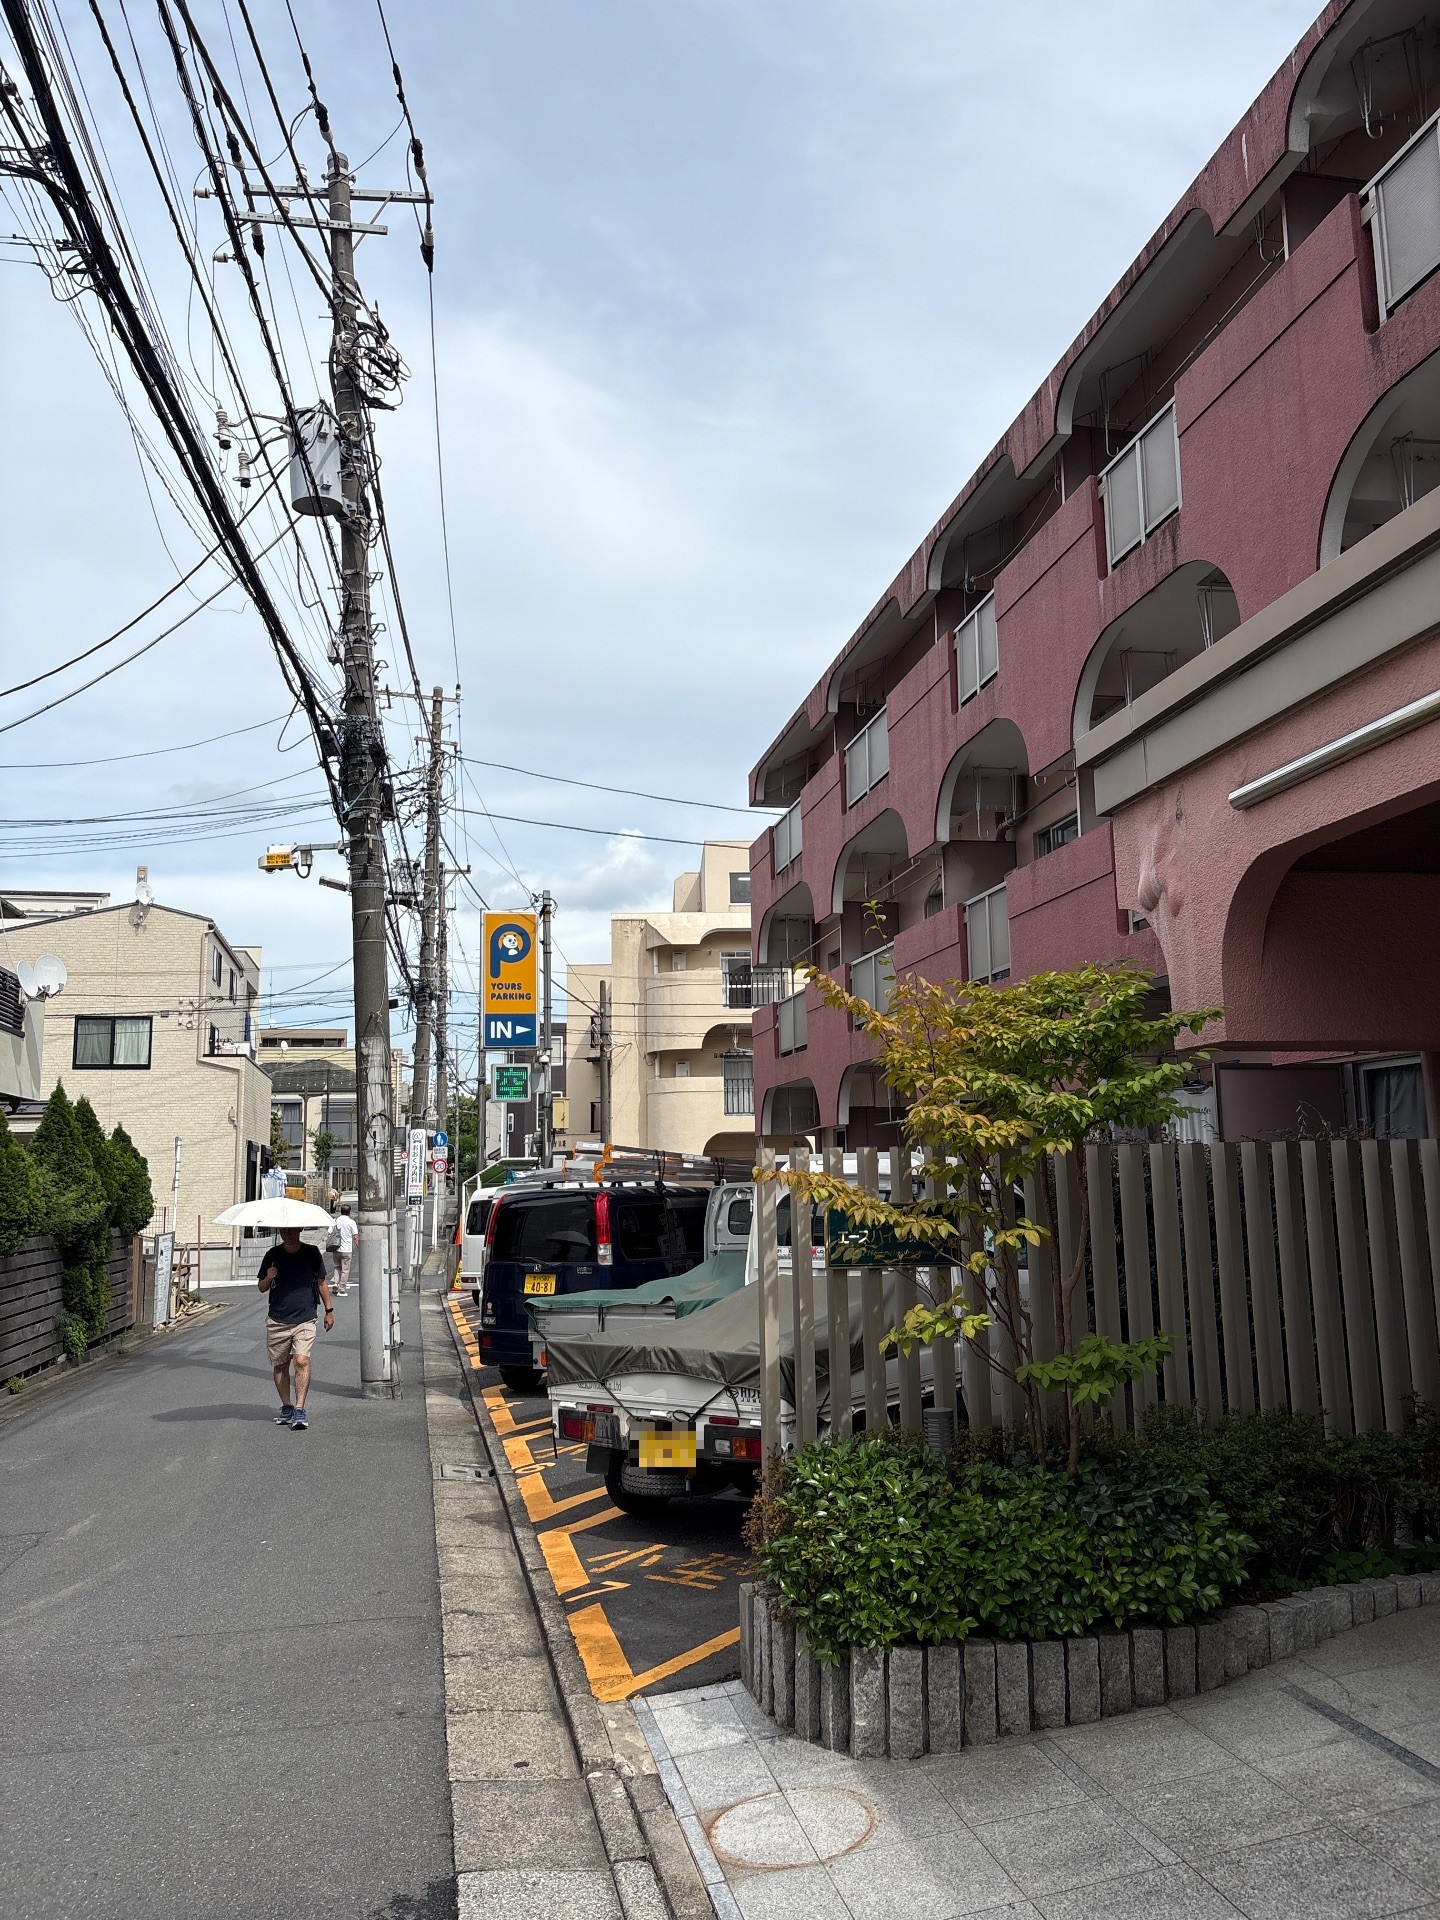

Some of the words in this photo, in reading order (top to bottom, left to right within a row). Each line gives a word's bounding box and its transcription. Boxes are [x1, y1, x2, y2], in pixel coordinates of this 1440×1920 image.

[491, 982, 522, 991] YOURS
[490, 992, 532, 1001] PARKING
[490, 1021, 512, 1039] IN
[495, 1067, 527, 1099] 空
[435, 1162, 445, 1170] 20
[531, 1281, 553, 1293] 40-81
